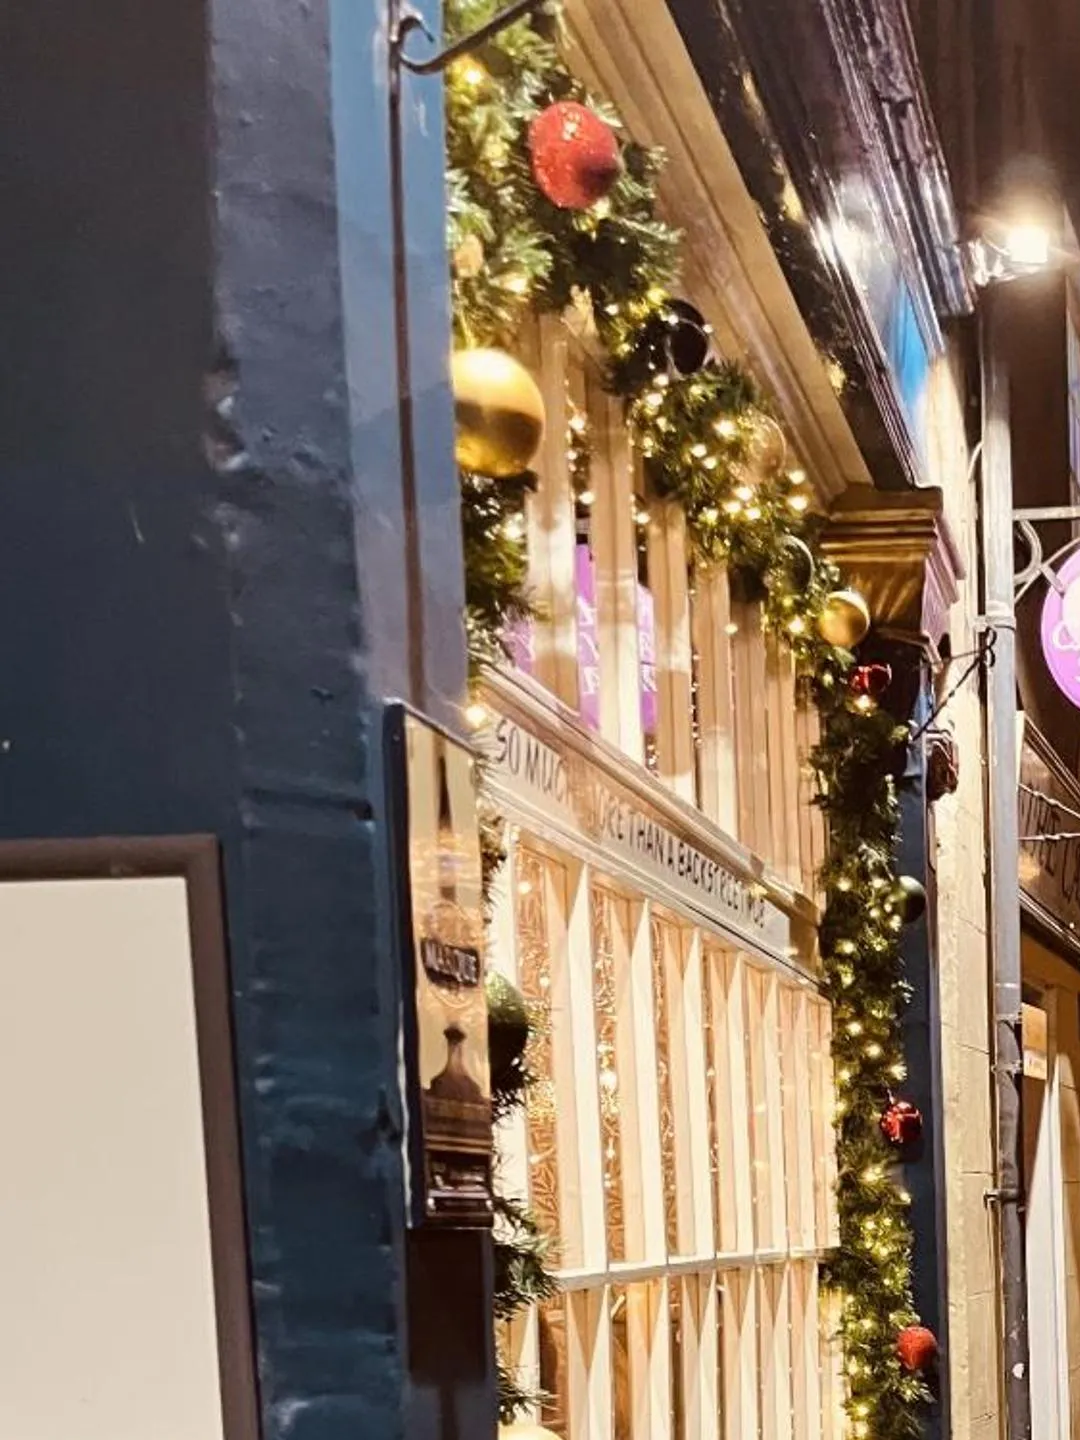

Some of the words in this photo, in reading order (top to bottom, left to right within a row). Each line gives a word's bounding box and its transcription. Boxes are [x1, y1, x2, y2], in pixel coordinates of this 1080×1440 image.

[496, 718, 520, 776] SO
[526, 737, 576, 806] MUC
[627, 805, 665, 864] THAN
